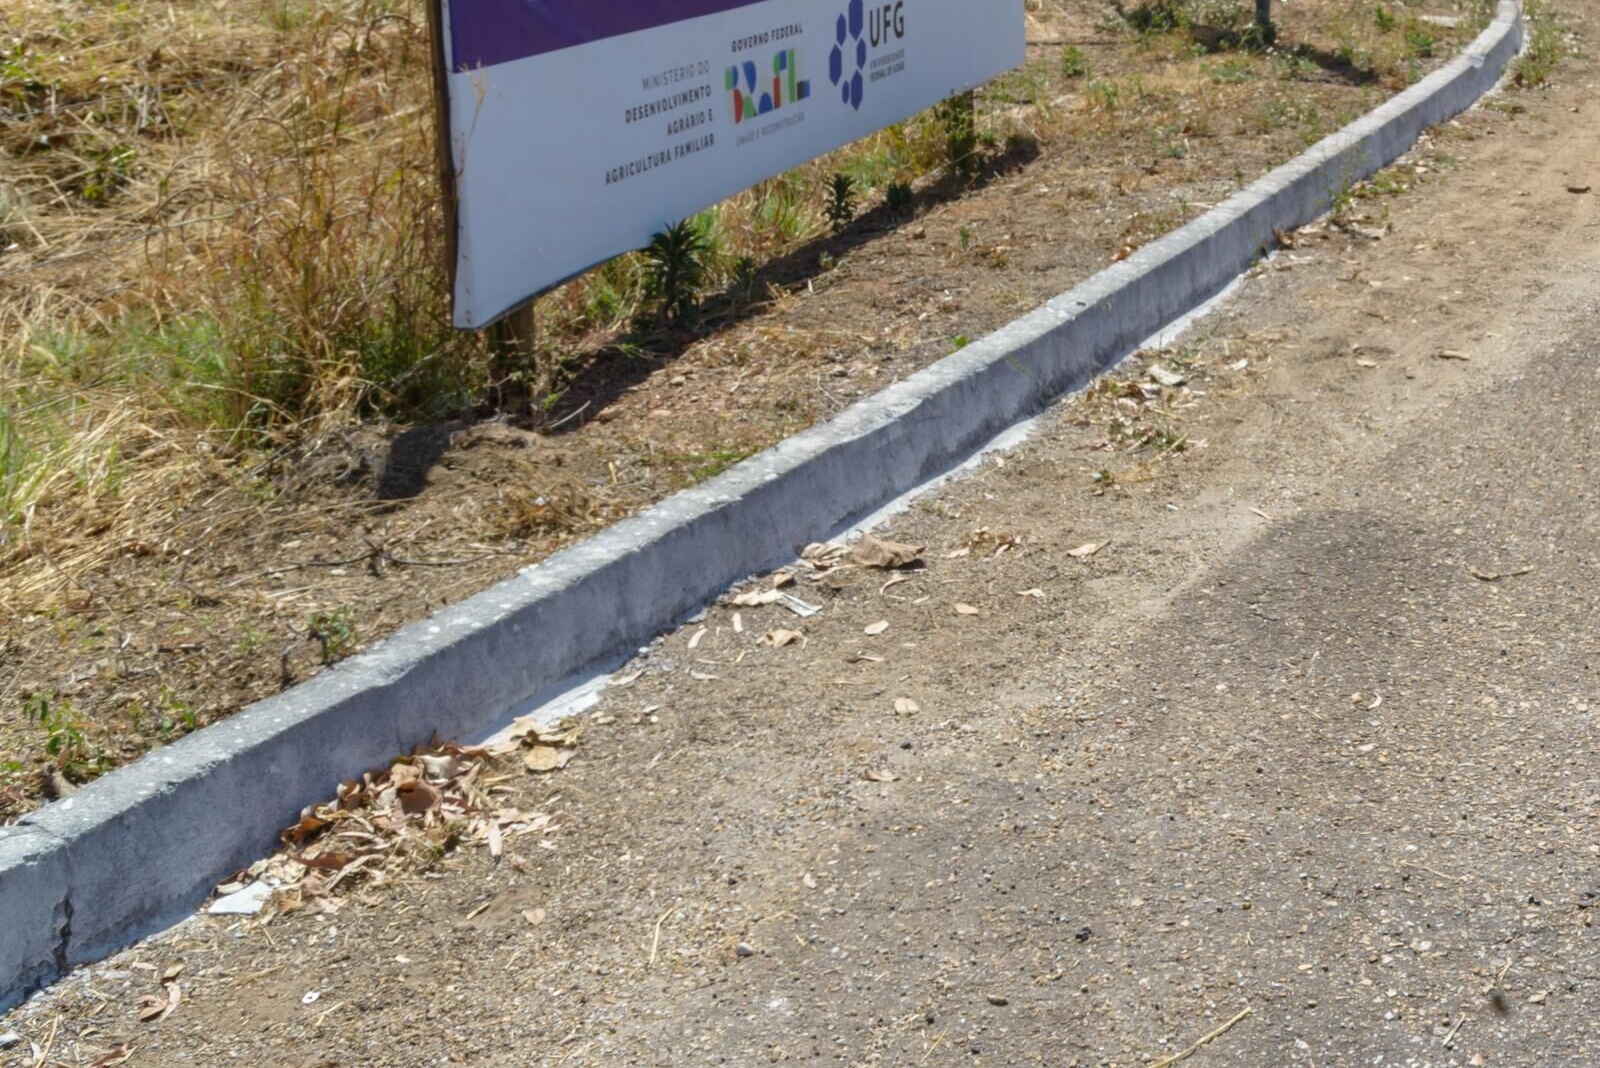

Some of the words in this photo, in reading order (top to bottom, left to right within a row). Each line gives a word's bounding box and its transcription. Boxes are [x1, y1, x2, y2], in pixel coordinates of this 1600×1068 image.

[731, 31, 769, 53] GOVERNO
[771, 22, 803, 42] FEDERAL
[869, 0, 904, 48] UFG
[698, 59, 711, 75] DO
[625, 84, 711, 124] DESENVOLVIMENTO
[708, 108, 713, 122] E
[605, 149, 672, 185] AGRICULTURA
[674, 133, 714, 159] FAMILIAR
